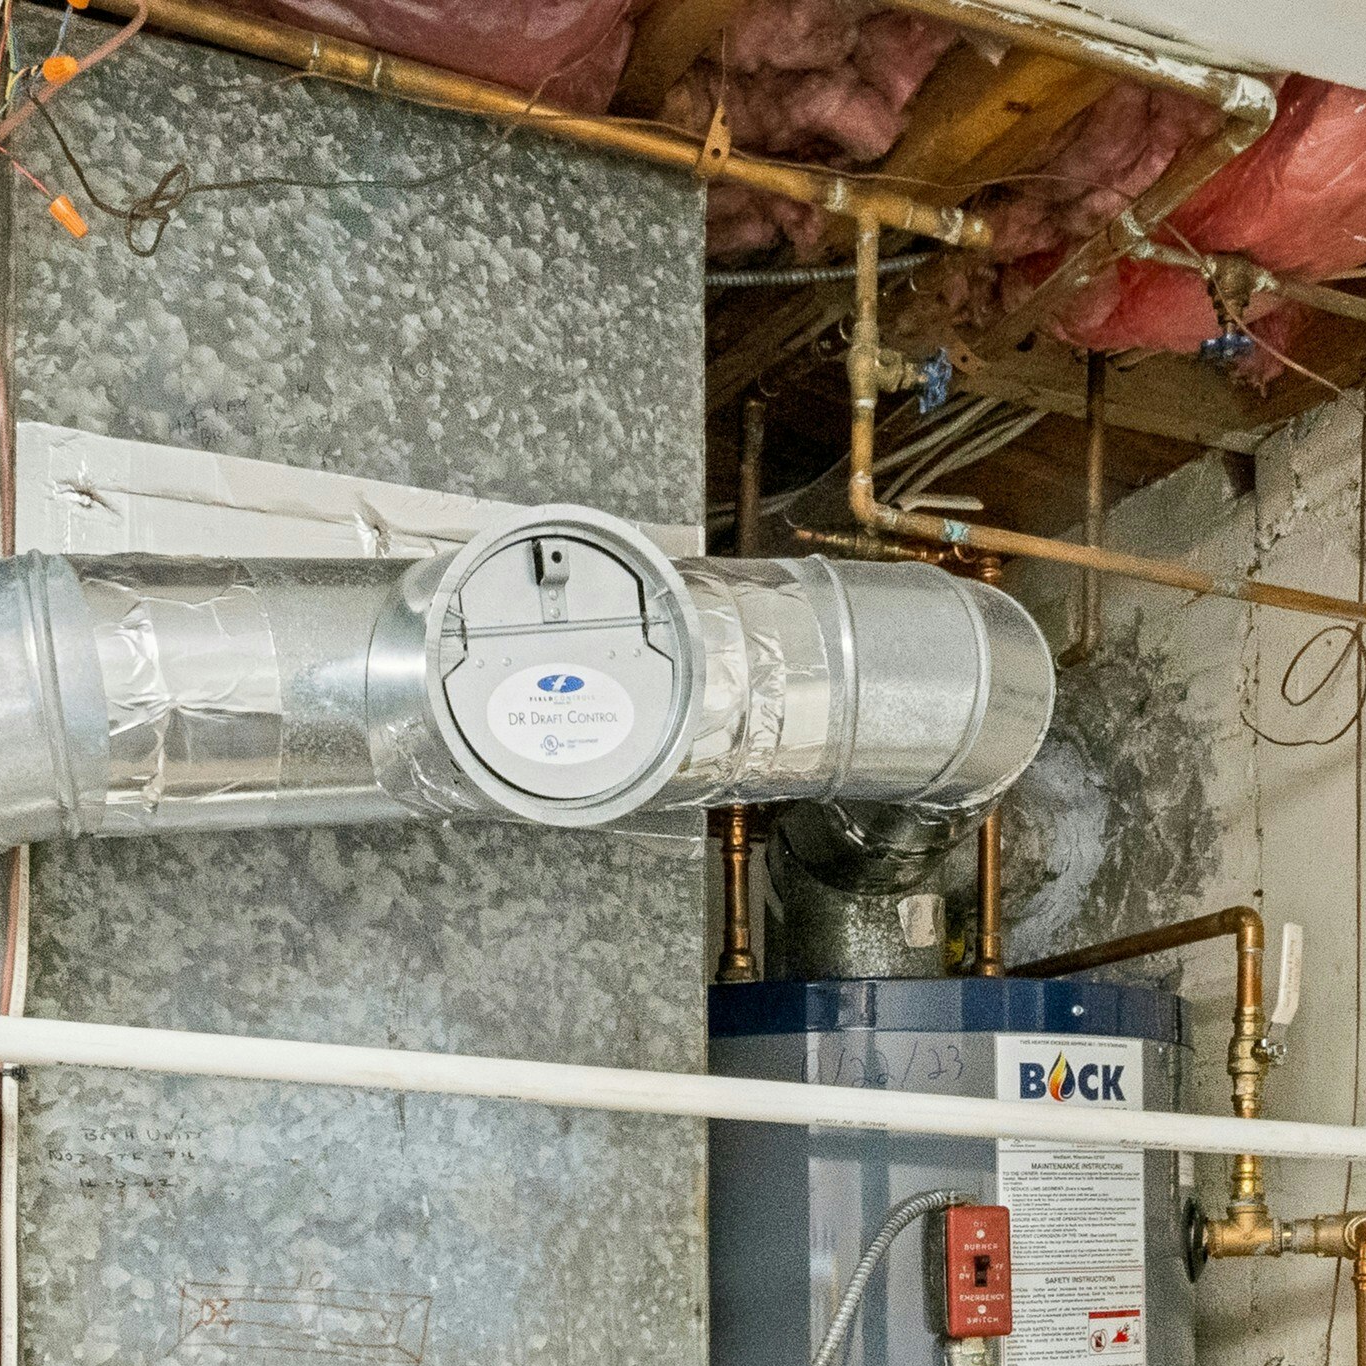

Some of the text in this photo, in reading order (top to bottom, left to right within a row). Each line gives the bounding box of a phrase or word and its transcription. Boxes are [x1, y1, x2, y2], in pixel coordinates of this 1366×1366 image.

[508, 710, 618, 726] DR DRAFT CONTROL
[1030, 1162, 1124, 1170] MAINTENANCE INSTRUCTIONS
[963, 1242, 998, 1251] BURNER
[1045, 1275, 1116, 1284] SAFETY INSTRUCTIONS
[966, 1317, 999, 1325] SWITCH
